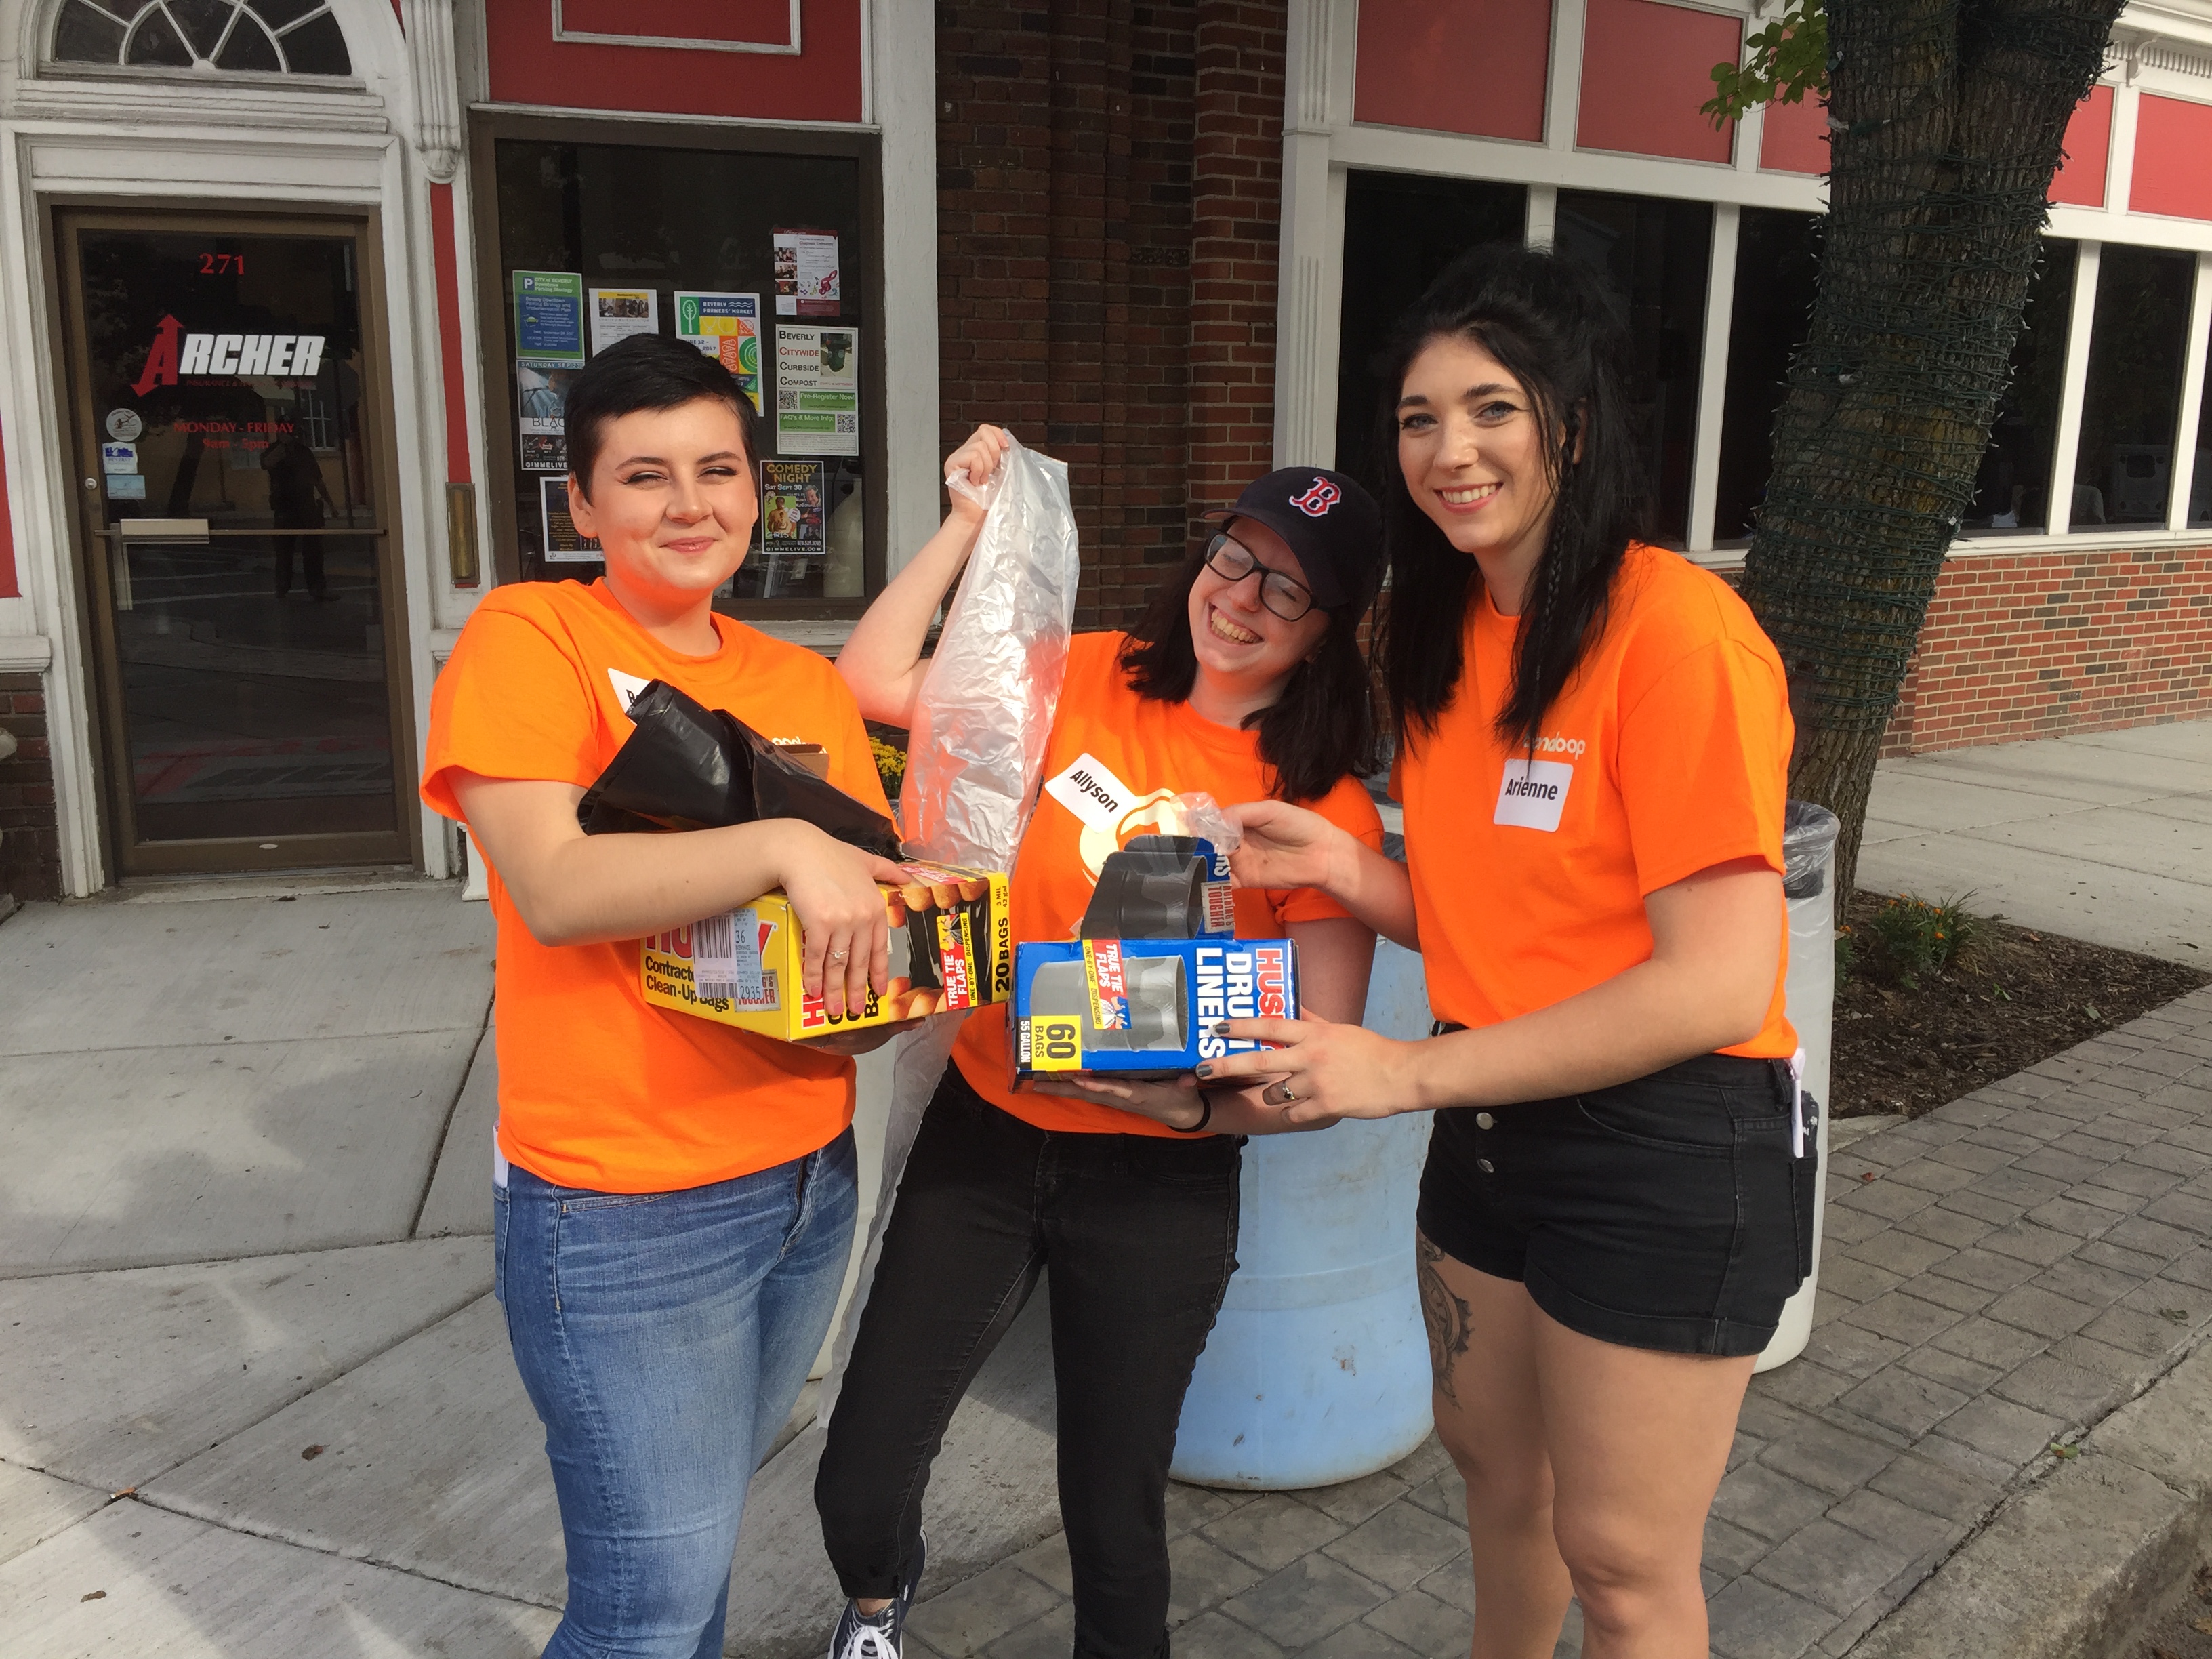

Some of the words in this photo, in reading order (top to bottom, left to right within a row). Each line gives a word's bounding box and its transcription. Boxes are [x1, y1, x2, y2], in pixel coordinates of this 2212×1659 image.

[199, 253, 245, 275] 271
[779, 331, 815, 340] BEVERLY
[131, 314, 325, 397] ARCHER
[779, 347, 819, 356] CITYWIDE
[780, 361, 819, 371] CURBSIDE
[780, 376, 817, 386] COMPOST
[800, 393, 838, 401] Pre-Register
[173, 422, 237, 433] MONDAY
[247, 422, 294, 433] FRIDAY
[203, 438, 230, 449] 9am
[241, 438, 270, 451] 5pm
[767, 464, 817, 473] COMEDY
[774, 474, 811, 483] NIGHT
[1289, 476, 1341, 517] B
[1069, 769, 1118, 813] Allyson
[1505, 776, 1558, 800] Arienne
[1208, 886, 1225, 928] TOUGHER
[735, 930, 745, 943] 36
[962, 918, 972, 956] DISPENSING
[998, 917, 1009, 960] BAGS
[645, 956, 694, 983] Contract
[944, 954, 955, 974] TIE
[1095, 952, 1111, 987] FLAPS
[1105, 943, 1121, 973] TRUE
[945, 975, 958, 1006] TRUE
[955, 959, 968, 994] FLAPS
[967, 961, 976, 1000] ONE-BY-ONE
[995, 962, 1010, 993] 20
[1085, 946, 1095, 983] ONE-BY-ONE
[1091, 988, 1101, 1025] DISPENSING
[1111, 974, 1124, 993] TIE
[741, 985, 761, 1000] 2935
[1196, 948, 1226, 1059] LINERS
[1256, 948, 1286, 1050] HUS
[1020, 1021, 1030, 1031] 55
[1020, 1032, 1031, 1063] GALLON
[1035, 1025, 1044, 1058] BAGS
[1046, 1024, 1076, 1059] 60
